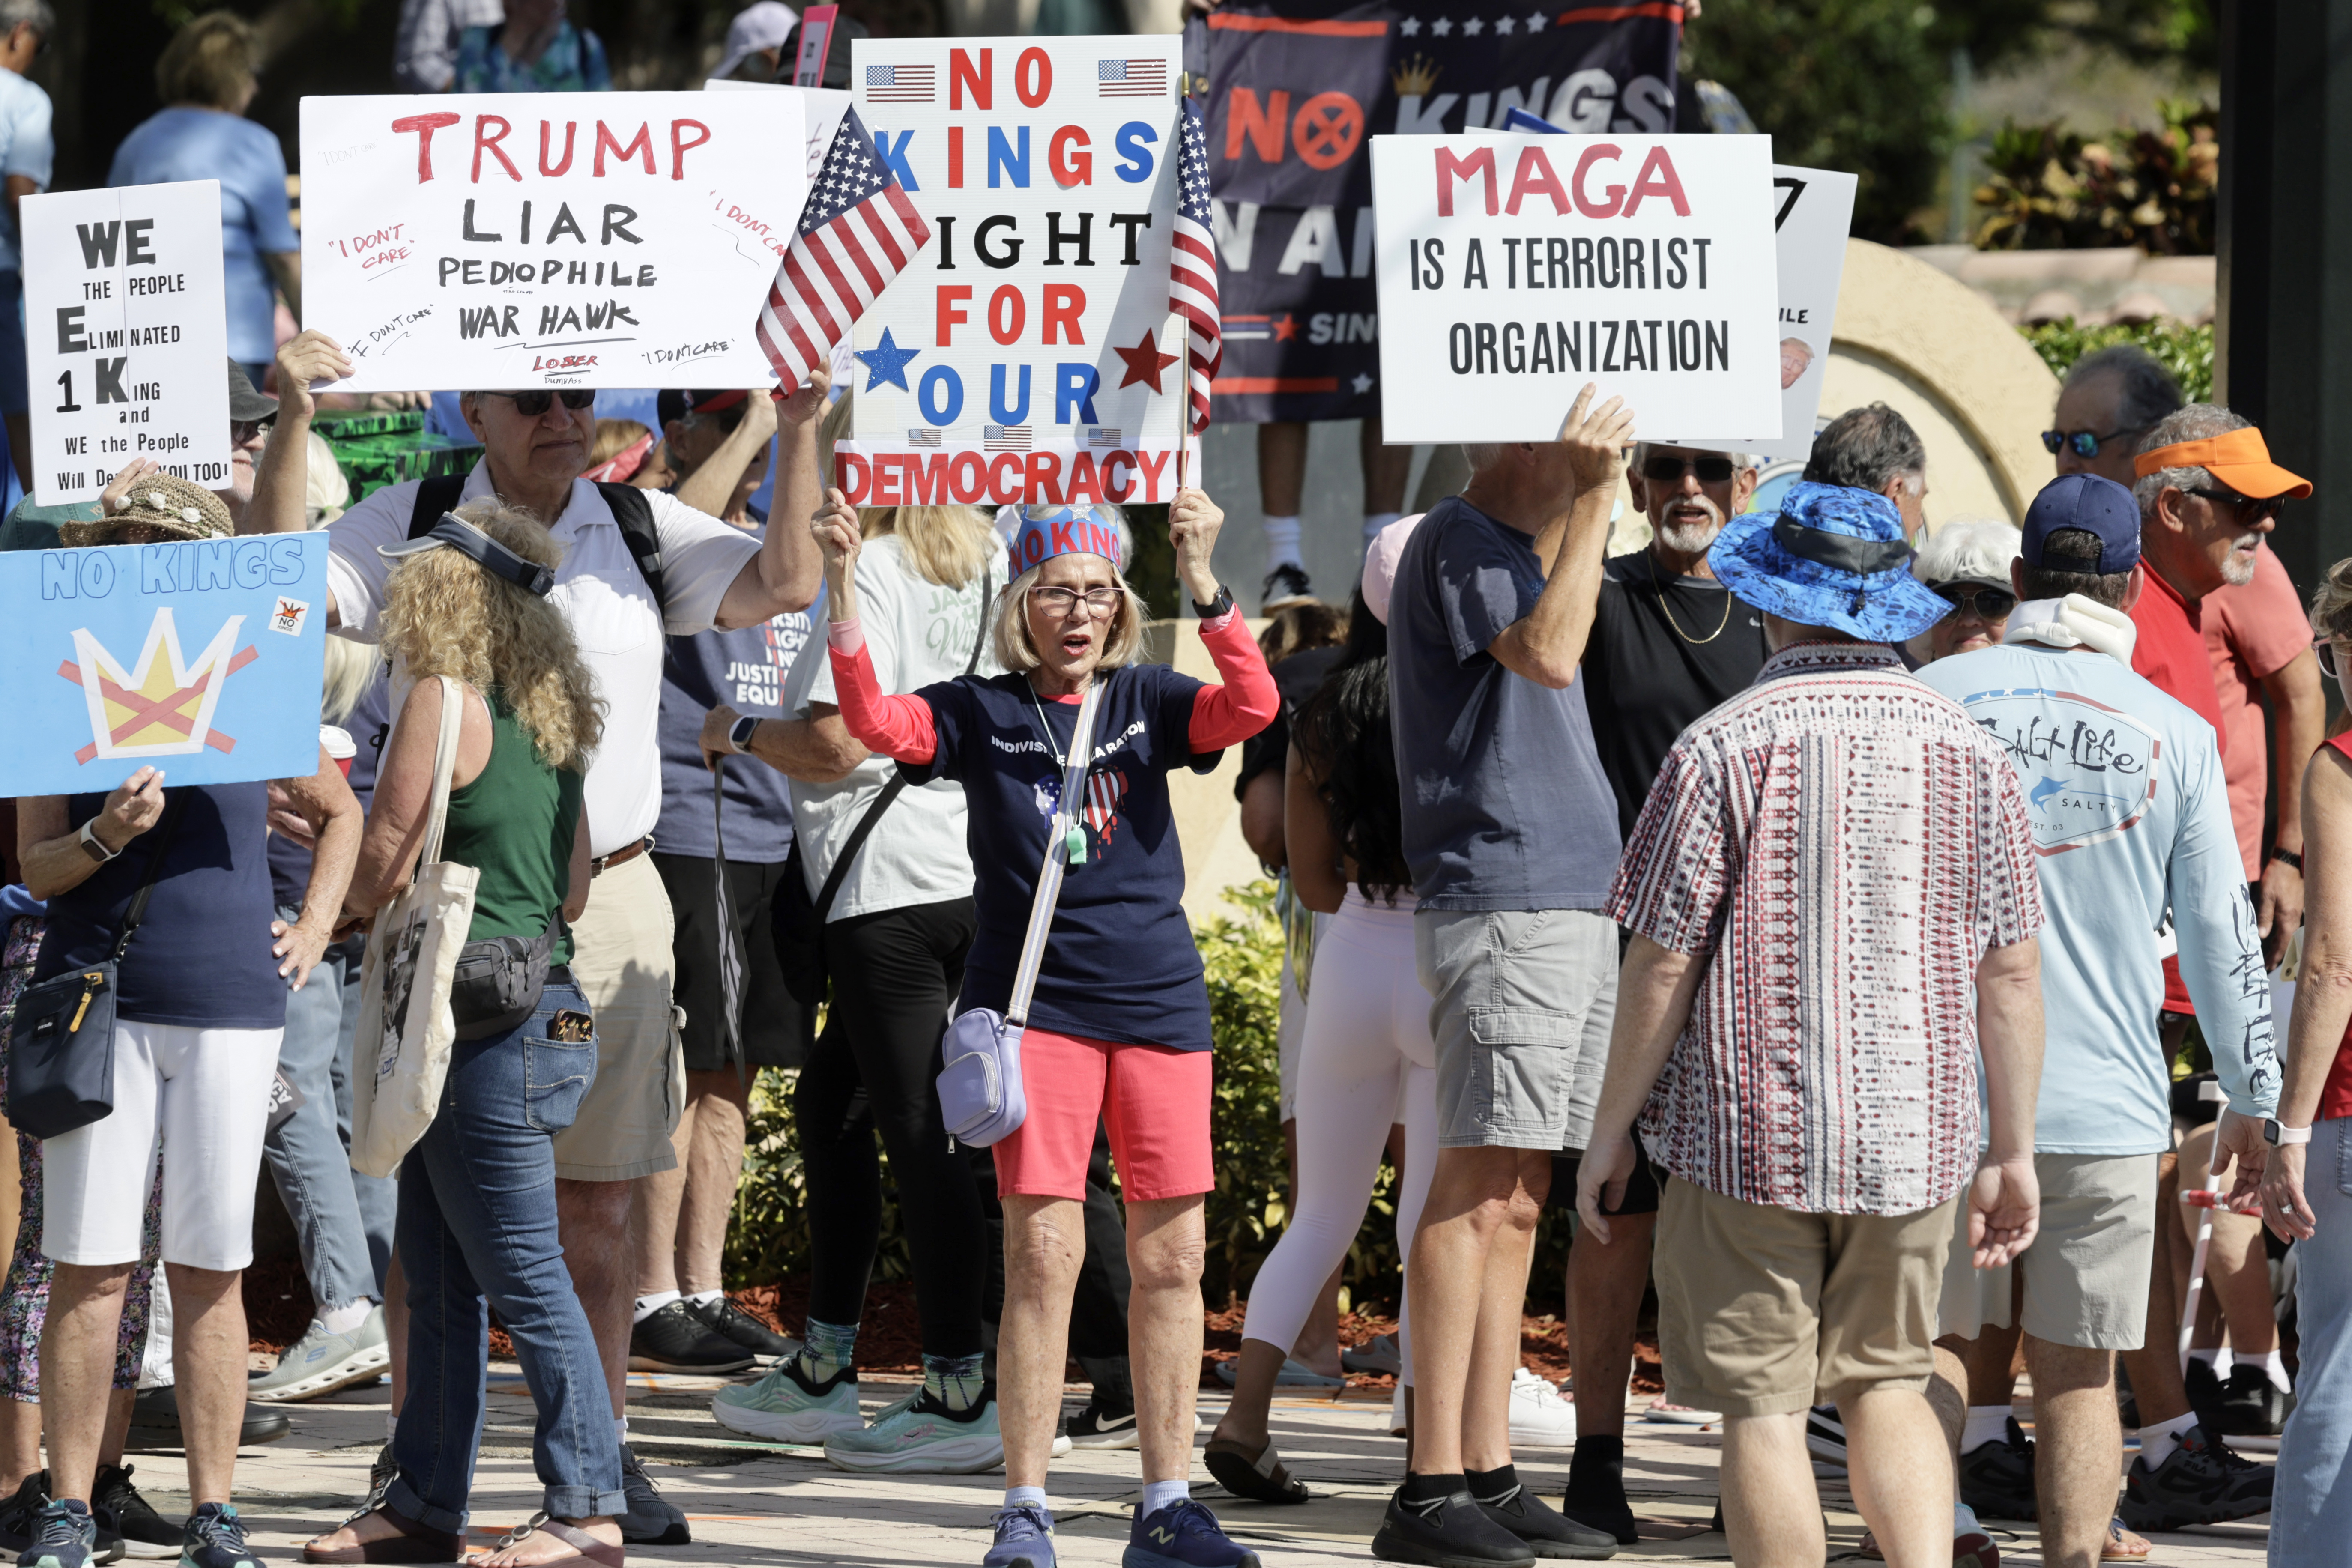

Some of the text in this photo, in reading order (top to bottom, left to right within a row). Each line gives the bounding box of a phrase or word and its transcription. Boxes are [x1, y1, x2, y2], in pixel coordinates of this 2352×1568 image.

[950, 46, 1053, 110] NO
[391, 111, 711, 184] TRUMP
[1435, 143, 1692, 219] MAGA
[76, 218, 156, 269] WE
[353, 223, 404, 253] DON'T
[462, 199, 643, 245] LIAR
[83, 274, 185, 300] THE PEOPLE
[1411, 238, 1444, 290] IS
[1464, 238, 1488, 289] A
[1503, 236, 1711, 290] TERRORIST
[57, 305, 180, 354] ELIMINATED
[459, 299, 640, 340] WAR HAWK
[936, 283, 1087, 347] FOR
[532, 355, 598, 372] LOSER
[1449, 319, 1728, 375] ORGANIZATION
[56, 357, 161, 412] 1 KING
[918, 363, 1100, 426] OUR
[120, 406, 149, 424] and
[65, 433, 189, 455] WE the People
[58, 472, 85, 490] Will
[42, 538, 305, 600] NO KINGS
[1009, 529, 1045, 581] NO
[279, 616, 295, 627] NO
[1106, 720, 1145, 754] RATON
[2062, 798, 2116, 813] SALTY
